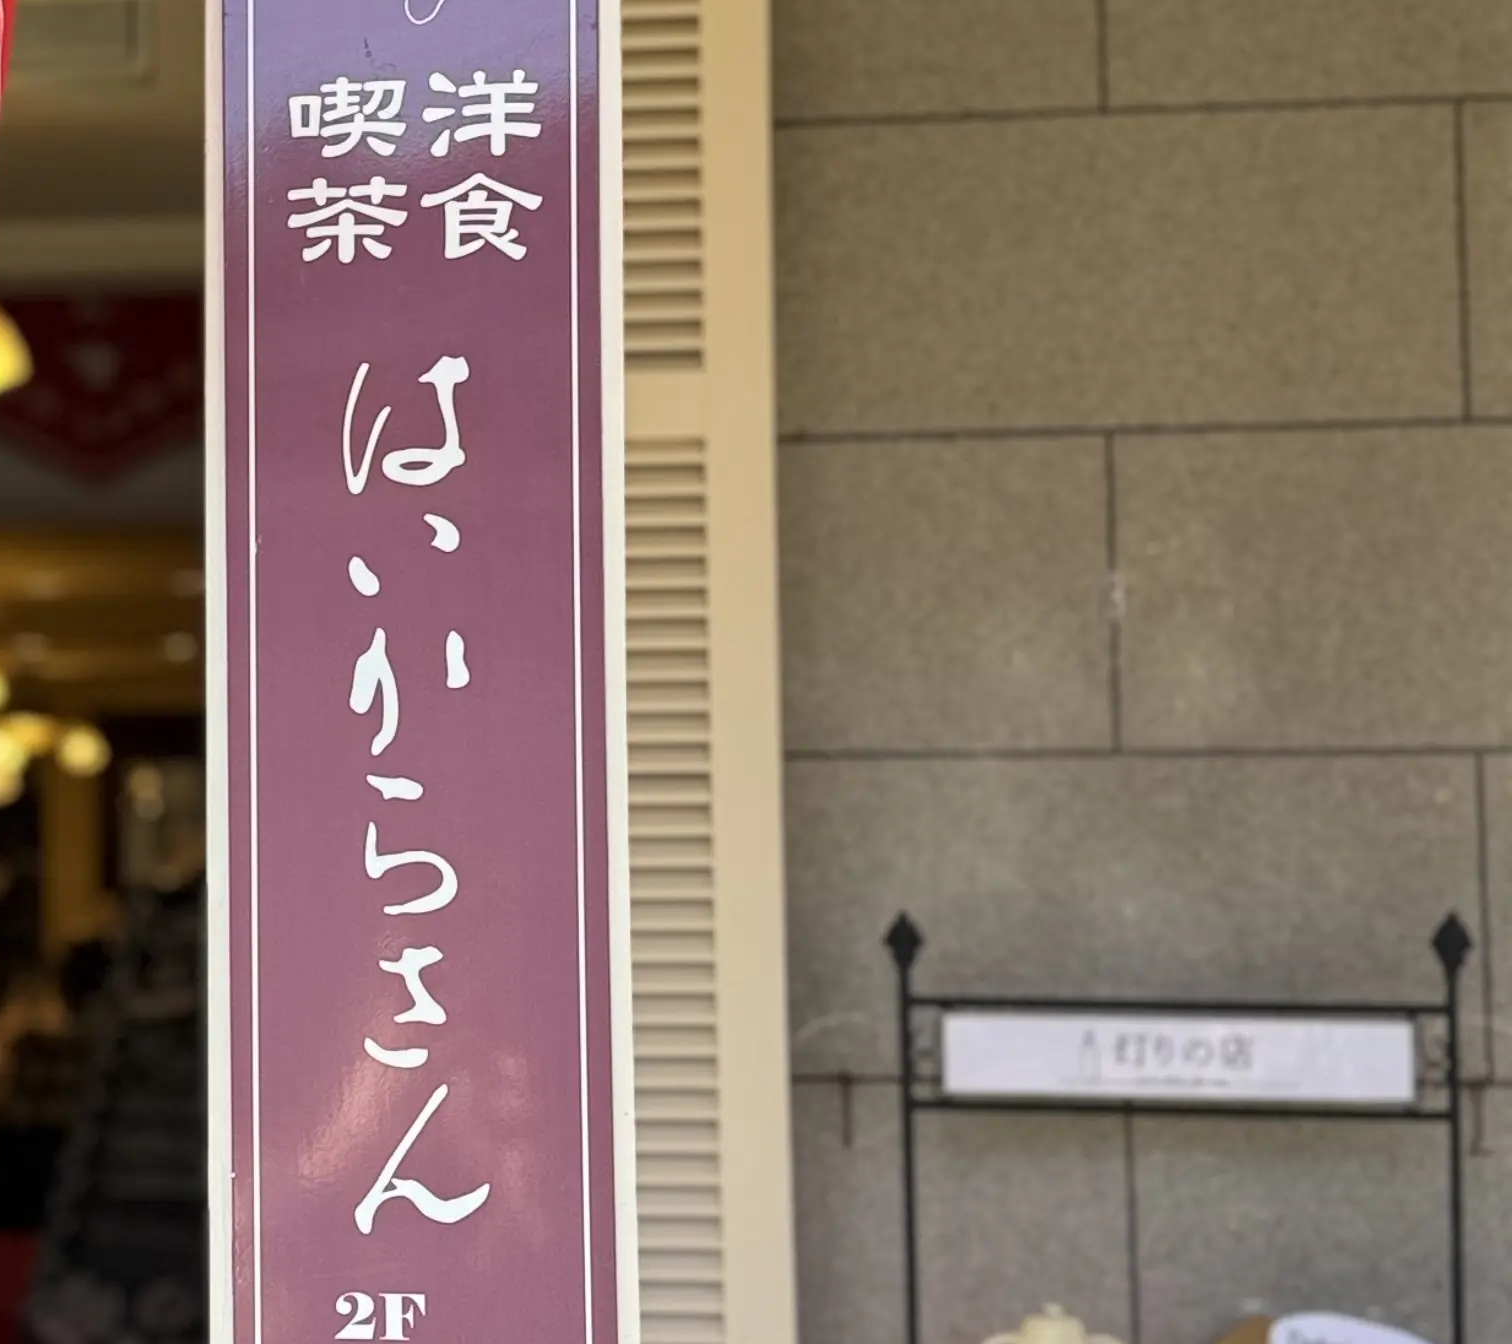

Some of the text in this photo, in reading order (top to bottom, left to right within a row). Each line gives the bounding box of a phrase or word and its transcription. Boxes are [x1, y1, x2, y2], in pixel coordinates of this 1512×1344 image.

[287, 76, 408, 263] 喫茶
[421, 69, 544, 261] 洋食
[342, 355, 491, 1235] はいからさん
[333, 1291, 427, 1342] 2F
